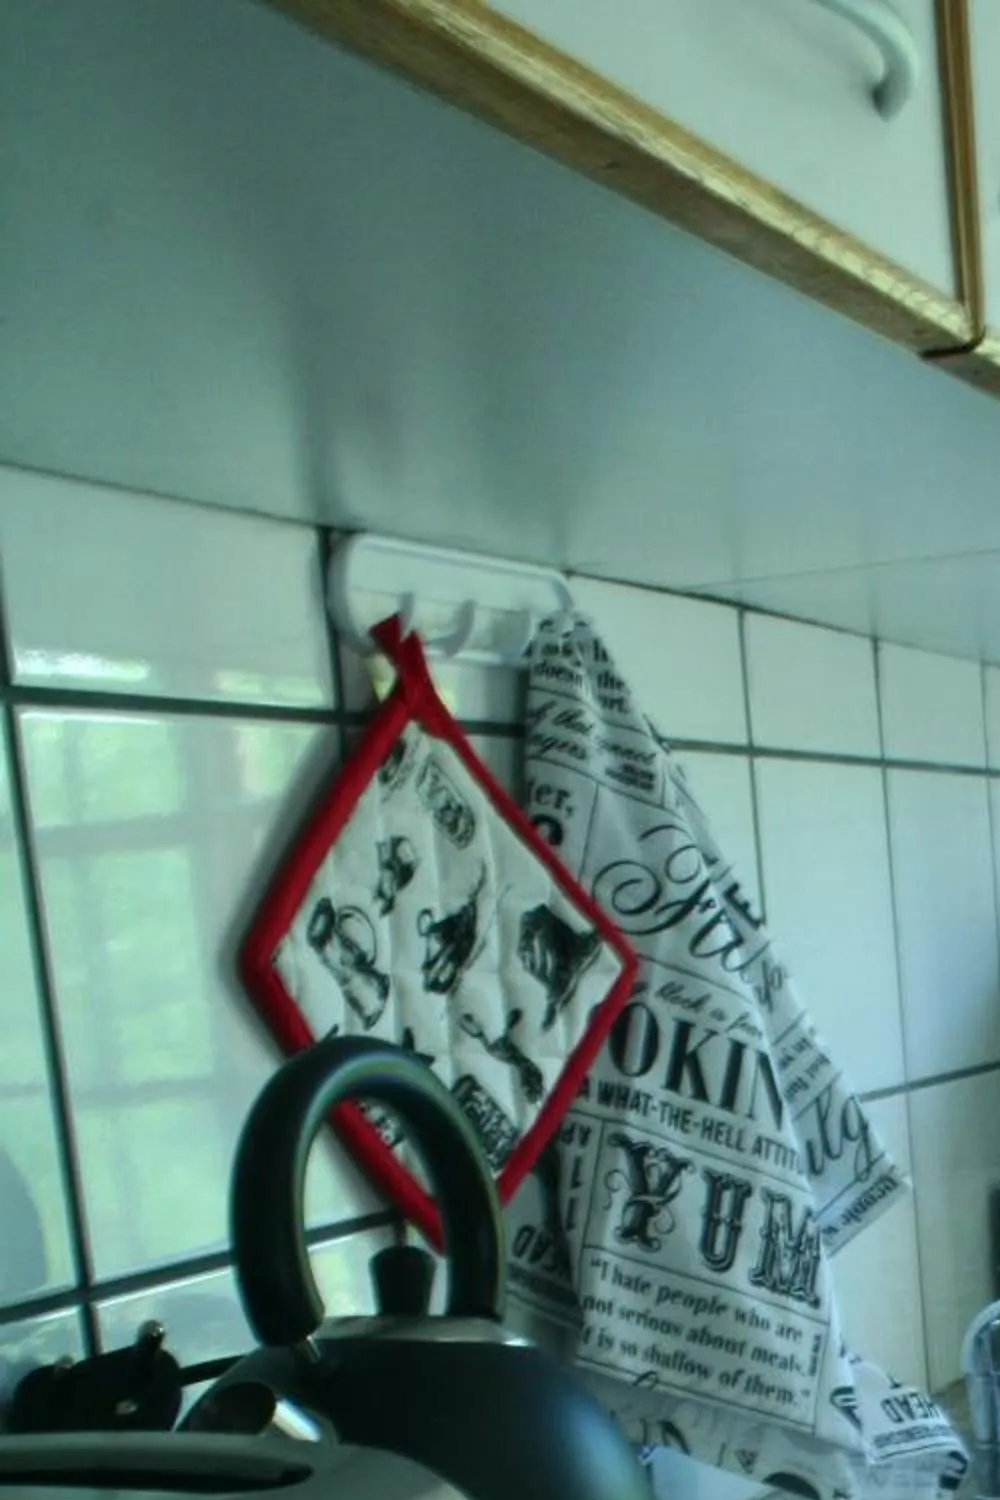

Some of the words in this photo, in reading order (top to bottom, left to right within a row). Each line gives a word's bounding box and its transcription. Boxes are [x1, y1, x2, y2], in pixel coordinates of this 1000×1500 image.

[598, 1080, 745, 1152] WHAT-THE-HELL
[602, 1132, 821, 1310] YUM
[582, 1293, 614, 1315] not
[619, 1304, 683, 1336] serious
[686, 1324, 748, 1358] about
[612, 1266, 652, 1294] hate
[657, 1285, 729, 1318] people
[733, 1307, 771, 1331] who
[775, 1322, 804, 1342] are
[597, 1329, 616, 1350] is
[620, 1339, 639, 1357] so
[641, 1344, 712, 1381] shallow
[718, 1367, 741, 1387] of
